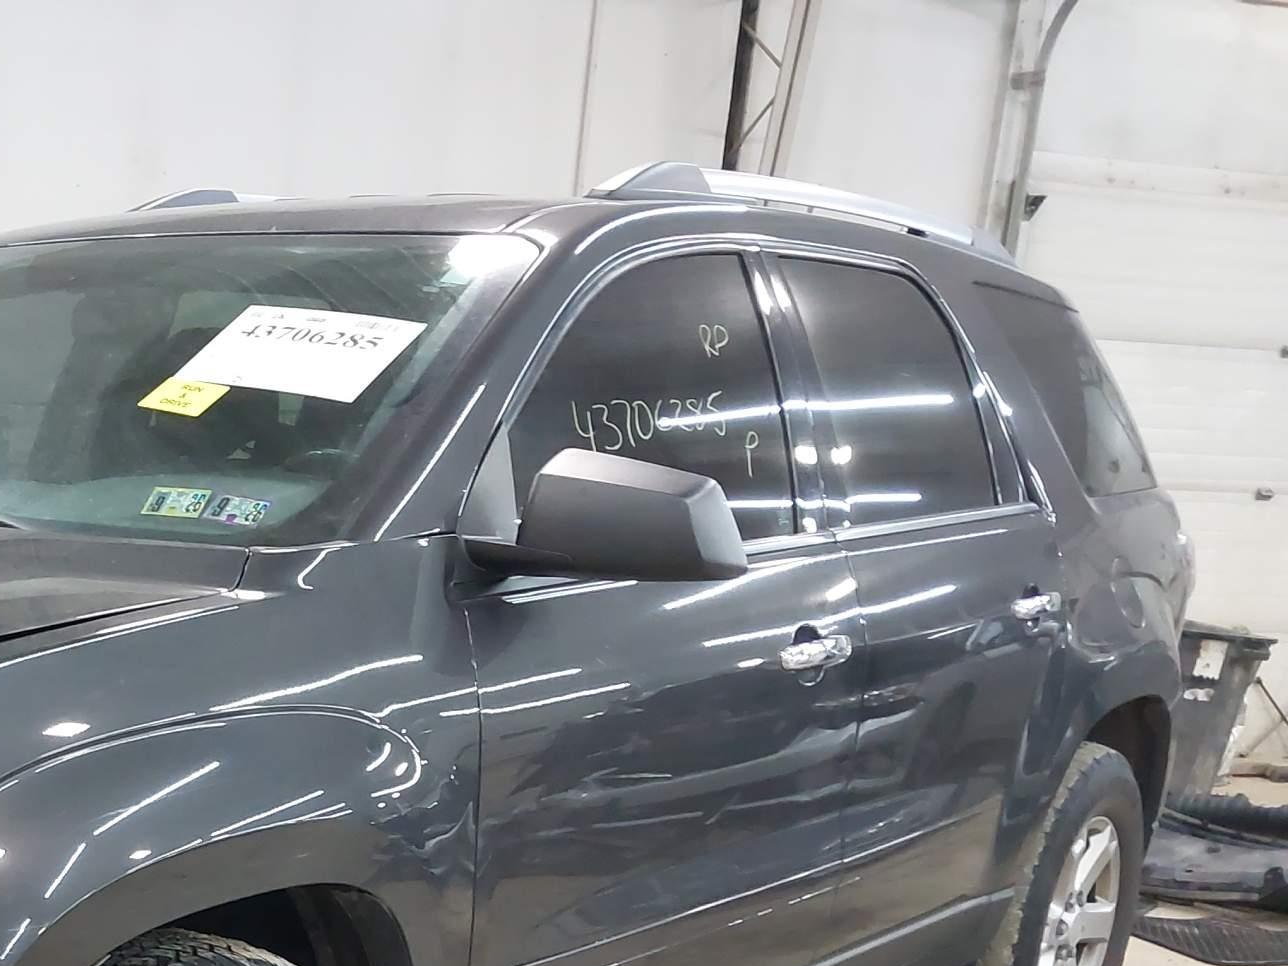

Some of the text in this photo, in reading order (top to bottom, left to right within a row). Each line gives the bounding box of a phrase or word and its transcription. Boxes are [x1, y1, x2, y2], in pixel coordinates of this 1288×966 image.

[240, 323, 385, 350] 43706285
[181, 384, 204, 393] RUN
[159, 397, 192, 408] DRIVE
[571, 390, 728, 452] 43706285
